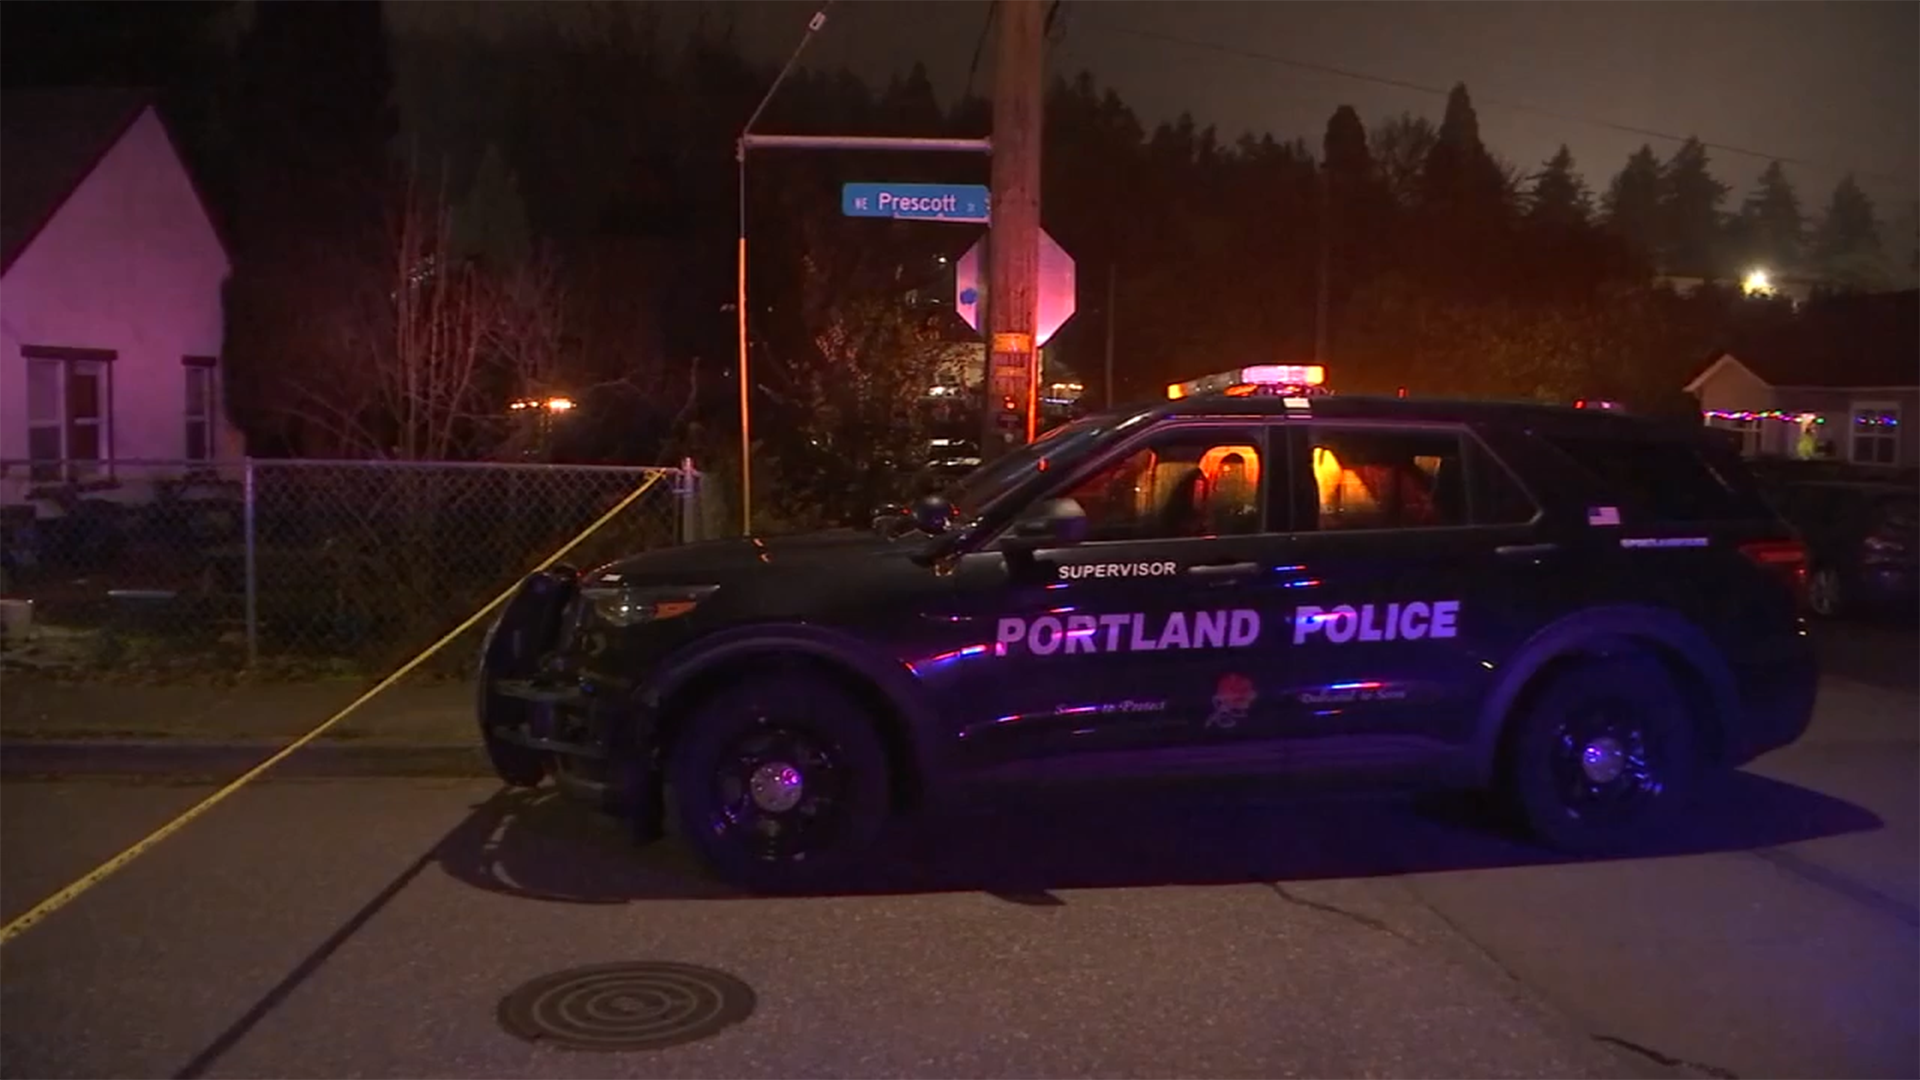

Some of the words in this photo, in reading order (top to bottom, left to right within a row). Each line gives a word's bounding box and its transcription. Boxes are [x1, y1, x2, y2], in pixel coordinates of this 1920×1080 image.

[854, 197, 868, 210] NE
[878, 192, 956, 211] Prescott
[1058, 562, 1176, 580] SUPERVISOR
[995, 609, 1260, 657] PORTLAND
[1293, 601, 1460, 644] POLICE
